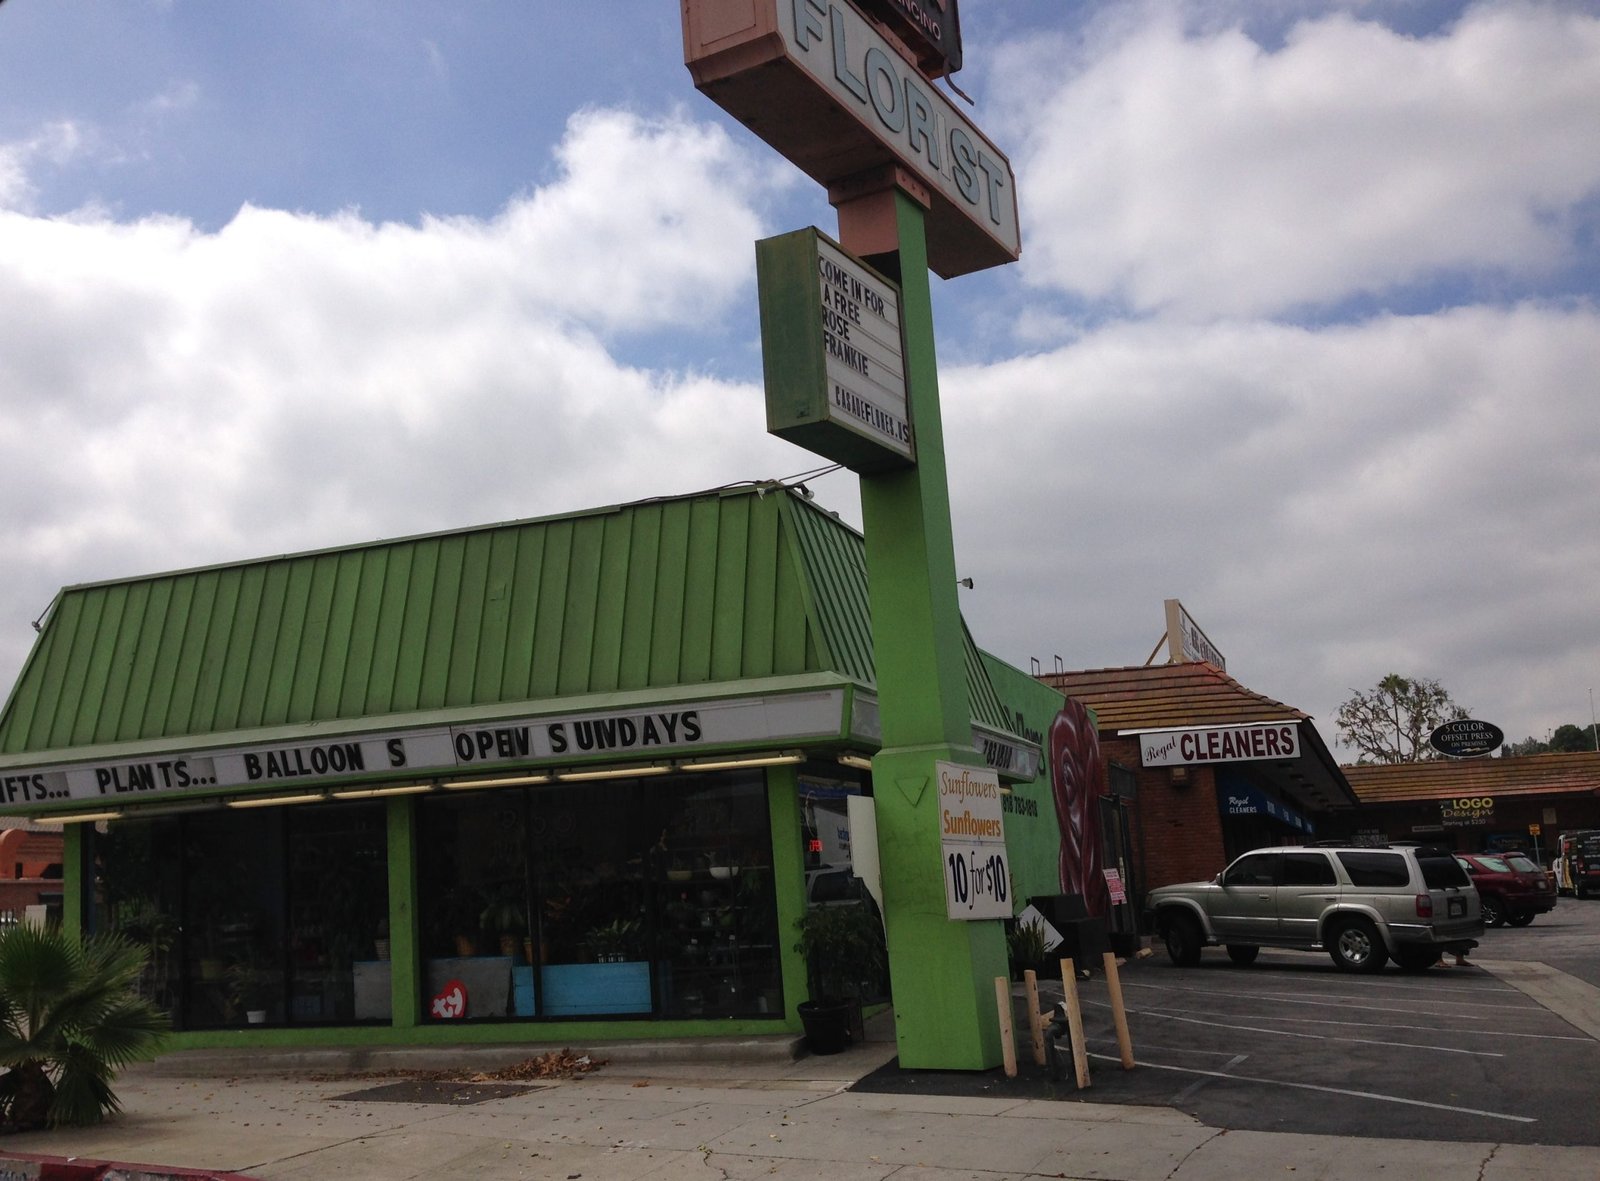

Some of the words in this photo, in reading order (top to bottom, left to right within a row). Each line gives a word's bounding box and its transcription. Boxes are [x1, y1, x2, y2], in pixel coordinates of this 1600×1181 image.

[792, 0, 1004, 225] FLORIST
[818, 256, 849, 293] COME
[850, 278, 862, 302] IN
[864, 288, 885, 319] FOR
[824, 283, 832, 305] A
[834, 290, 861, 325] FREE
[822, 305, 850, 341] ROSE
[823, 330, 869, 377] FRANKIE
[1145, 735, 1177, 762] Regal
[1180, 727, 1295, 761] CLEANERS
[1441, 733, 1468, 742] OFFSET
[1470, 731, 1494, 741] PRESS
[1452, 722, 1485, 733] COLOR
[95, 760, 216, 794] PLANTS...
[455, 726, 529, 761] OPEN
[548, 711, 702, 753] SUNDAYS
[941, 770, 998, 804] Sunflowers
[1452, 797, 1494, 809] LOGO
[943, 809, 1002, 837] Sunflowers
[1229, 806, 1257, 814] CLEANERS
[1442, 808, 1495, 818] Design
[949, 853, 968, 904] 10
[969, 850, 985, 911] for
[986, 855, 1007, 903] $10
